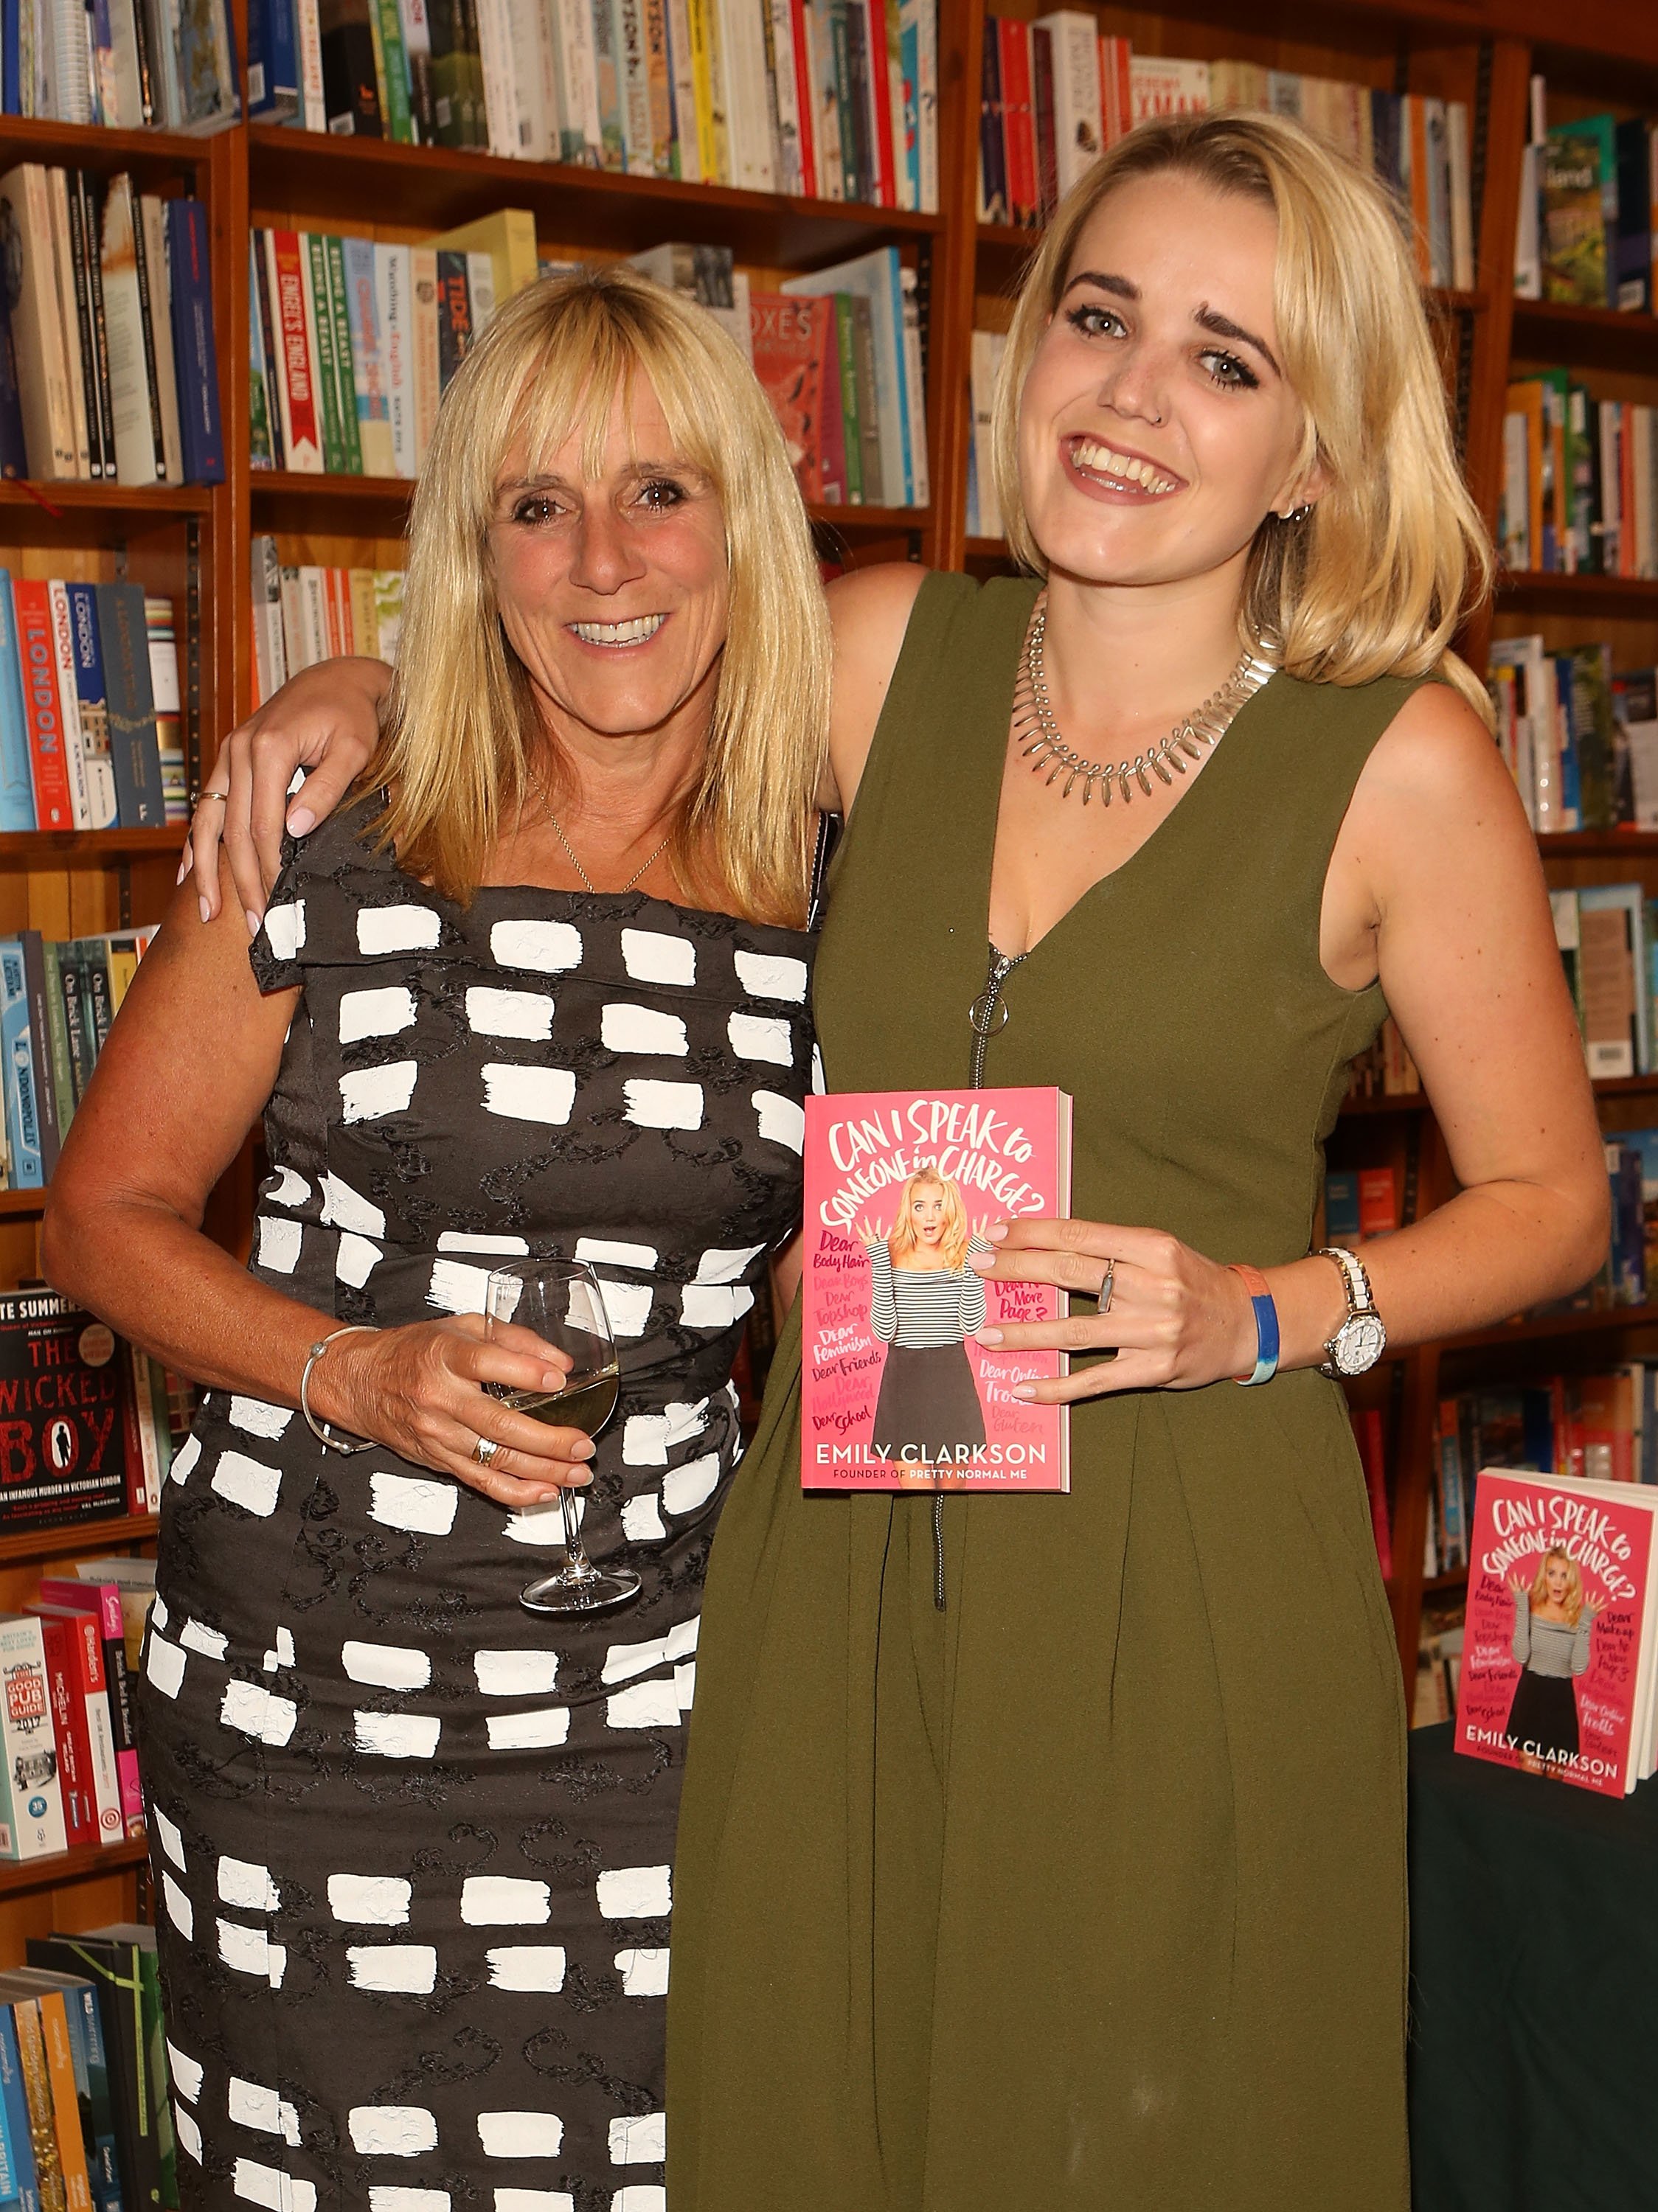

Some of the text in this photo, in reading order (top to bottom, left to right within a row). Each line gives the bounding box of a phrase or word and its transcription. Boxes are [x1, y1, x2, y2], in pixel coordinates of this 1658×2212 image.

[448, 274, 469, 332] TIDE
[318, 316, 332, 366] BEAST
[337, 318, 352, 368] BEAST
[285, 334, 310, 401] ENGLAND
[54, 588, 72, 670] LONDON
[74, 592, 94, 669] LONDON
[27, 627, 58, 754] LONDON
[92, 973, 107, 1026] On Brick
[64, 973, 80, 1058] On Brick Lane
[828, 1098, 1037, 1172] CAN I SPEAK to
[819, 1144, 1045, 1236] SOMEONE in CHARGE?
[819, 1230, 859, 1253] Dear
[813, 1253, 870, 1273] Body Hair
[814, 1273, 869, 1292] Dear Boys
[825, 1290, 855, 1307] Dear
[999, 1298, 1035, 1323] Page
[1014, 1290, 1044, 1307] More
[814, 1304, 868, 1327] Topshop
[28, 1328, 52, 1337] MAIL ON
[817, 1323, 859, 1346] Dear
[28, 1338, 77, 1368] THE
[813, 1335, 873, 1366] Feminism
[811, 1350, 882, 1382] Dear Friends
[979, 1359, 1011, 1380] Dear
[0, 1369, 117, 1414] WICKED
[811, 1405, 873, 1436] Dear School
[992, 1405, 1020, 1419] Dear
[993, 1417, 1044, 1434] Gluten
[0, 1407, 114, 1484] BOY
[816, 1443, 1047, 1465] EMILY CLARKSON
[0, 1474, 121, 1502] AN INFAMOUS MURDER IN VICTORIAN LONDON
[833, 1469, 1027, 1480] FOUNDER OF PRETTY NORMAL ME
[1492, 1495, 1632, 1561] CAN I SPEAK to
[1482, 1527, 1637, 1602] SOMEONE in CHARGE?
[1481, 1575, 1507, 1593] Dear
[1606, 1611, 1634, 1624] Dear
[86, 1637, 99, 1684] Harden's
[8, 1679, 41, 1693] GOOD
[10, 1689, 43, 1707] PUB
[55, 1672, 69, 1725] MICHELIN
[118, 1680, 128, 1697] Bed
[12, 1703, 44, 1717] GUIDE
[16, 1716, 41, 1731] 2017
[1466, 1725, 1618, 1780] EMILY CLARKSON
[1527, 1759, 1557, 1773] PRETTY
[1557, 1767, 1590, 1784] NORMAL
[0, 2142, 13, 2196] BRITAIN
